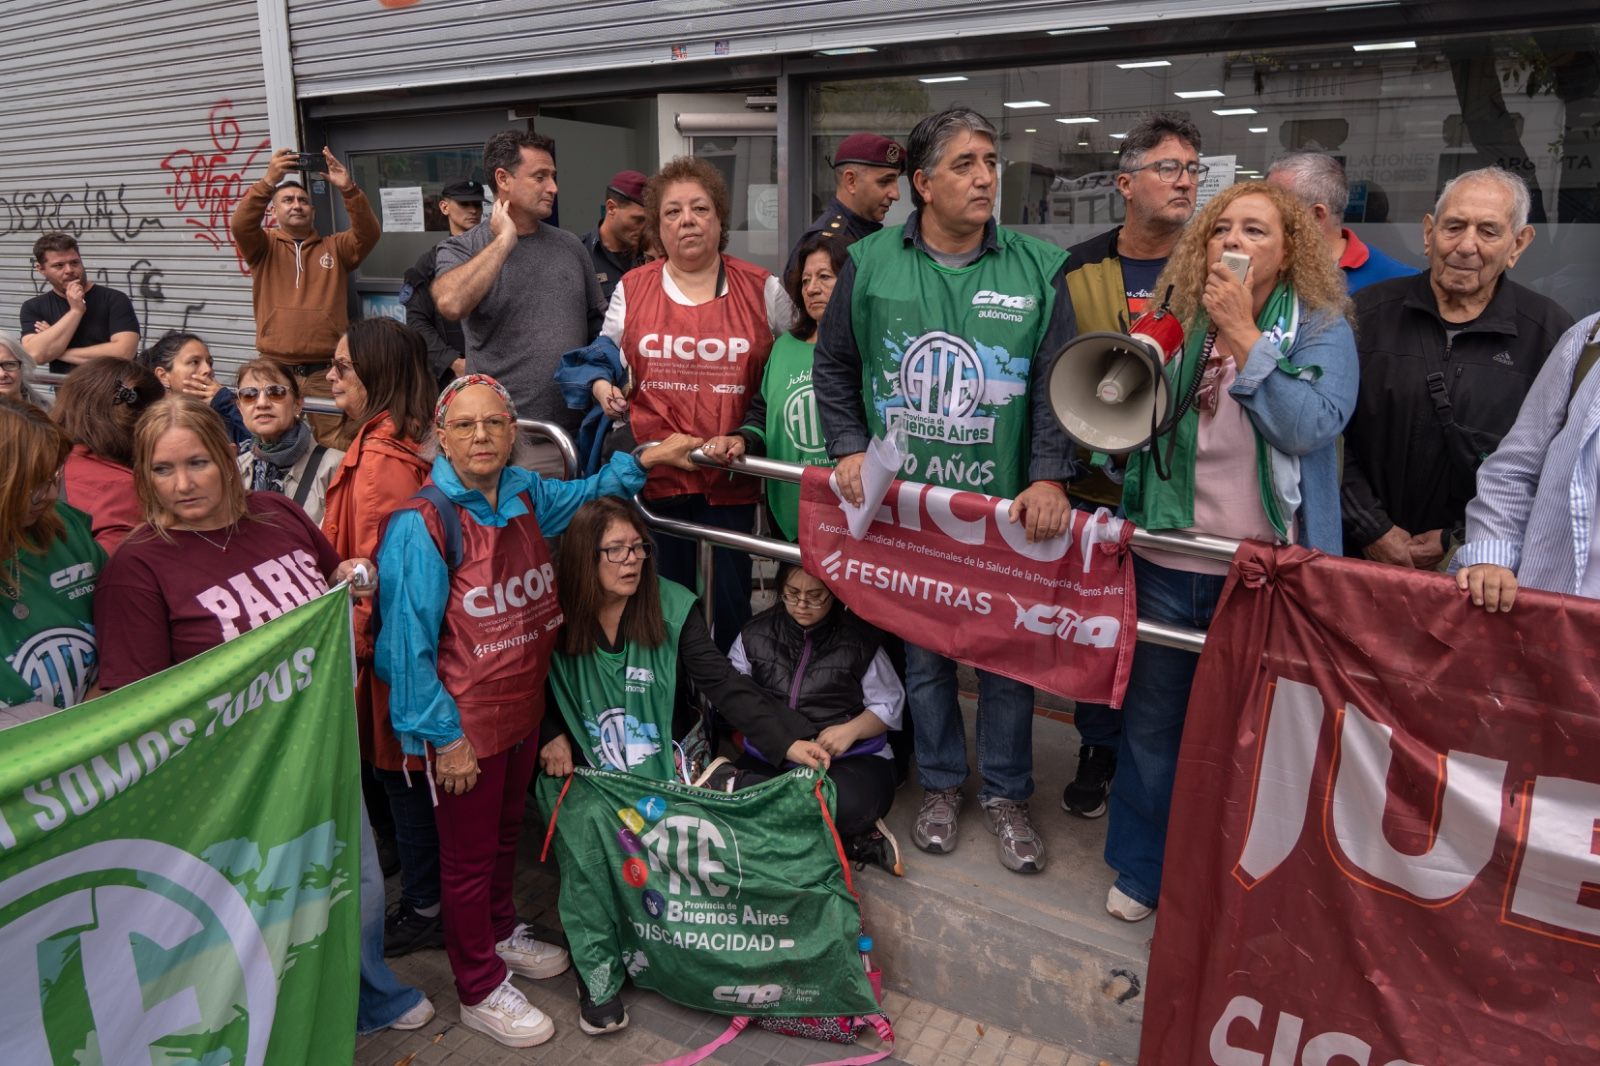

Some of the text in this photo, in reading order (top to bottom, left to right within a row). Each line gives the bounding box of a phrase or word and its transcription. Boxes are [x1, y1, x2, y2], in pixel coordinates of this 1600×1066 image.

[1349, 153, 1436, 167] LACIONES
[978, 310, 1023, 322] autónoma
[638, 333, 750, 362] CICOP
[647, 381, 700, 392] FESINTRAS
[786, 368, 812, 390] jubil
[908, 340, 974, 417] ATE
[948, 424, 989, 441] Aires
[925, 453, 995, 486] AÑOS
[818, 522, 852, 536] Asociac
[864, 532, 894, 546] Sindical
[895, 540, 906, 549] de
[907, 542, 962, 563] Profesionales
[963, 554, 975, 566] de
[976, 558, 985, 568] la
[986, 561, 1011, 575] Salud
[1012, 565, 1024, 578] de
[1024, 569, 1032, 581] la
[196, 549, 329, 642] PARIS
[463, 562, 554, 618] CICOP
[844, 558, 992, 615] FESINTRAS
[483, 629, 539, 654] FESINTRAS
[24, 718, 196, 831] SOMOS
[205, 647, 316, 737] TODOS
[641, 815, 730, 897] ATE
[666, 900, 790, 926] Buenos Aires
[684, 901, 737, 910] Provincia de
[633, 922, 775, 952] DISCAPACIDAD
[713, 984, 782, 1003] CTA
